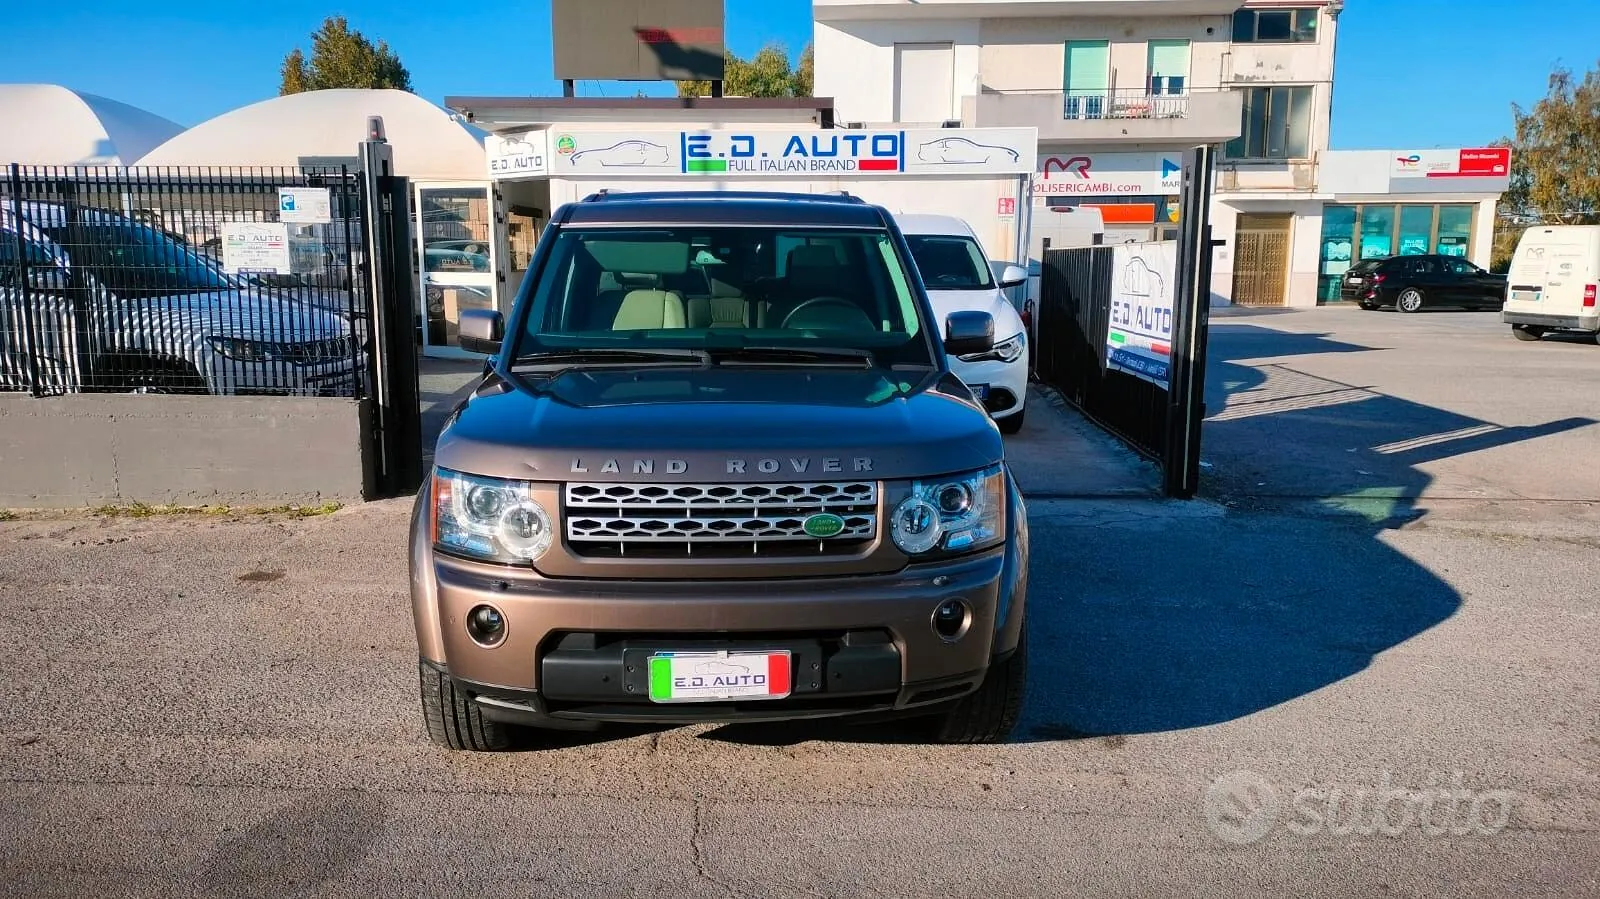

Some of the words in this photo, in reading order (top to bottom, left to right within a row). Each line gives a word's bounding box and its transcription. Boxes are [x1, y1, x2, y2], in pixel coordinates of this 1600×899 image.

[688, 135, 767, 158] E.D.
[783, 134, 898, 158] AUTO
[491, 158, 511, 170] E.D.
[514, 155, 542, 168] AUTO
[729, 160, 756, 171] FULL
[760, 159, 806, 171] ITALIAN
[810, 159, 856, 171] BRAND
[1031, 183, 1141, 193] OLISERICAMBI.com
[1112, 301, 1133, 326] E.D.
[1136, 305, 1171, 333] AUTO
[570, 458, 688, 474] LAND
[726, 457, 873, 474] ROVER
[674, 677, 708, 687] E.D.
[713, 675, 766, 686] AUTO
